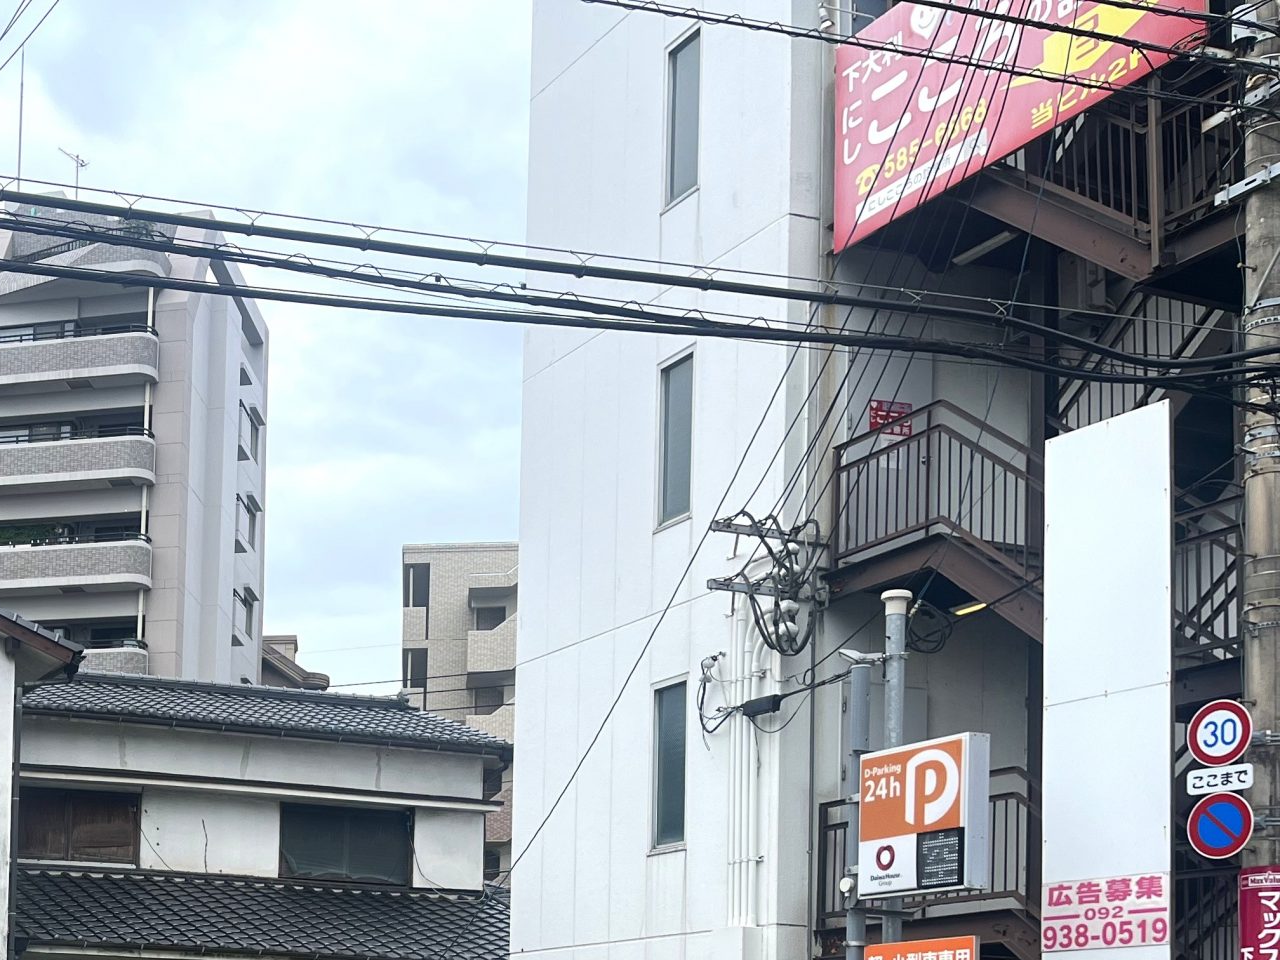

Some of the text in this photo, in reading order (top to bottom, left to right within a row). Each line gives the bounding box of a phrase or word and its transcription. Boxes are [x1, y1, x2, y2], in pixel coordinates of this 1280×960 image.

[1203, 718, 1237, 748] 30
[864, 763, 902, 778] D-Parking
[1192, 769, 1248, 789] ここまで
[864, 775, 901, 803] 24h
[1048, 876, 1163, 907] 広告募集
[1084, 905, 1124, 920] 092
[1043, 917, 1167, 950] 938-0519
